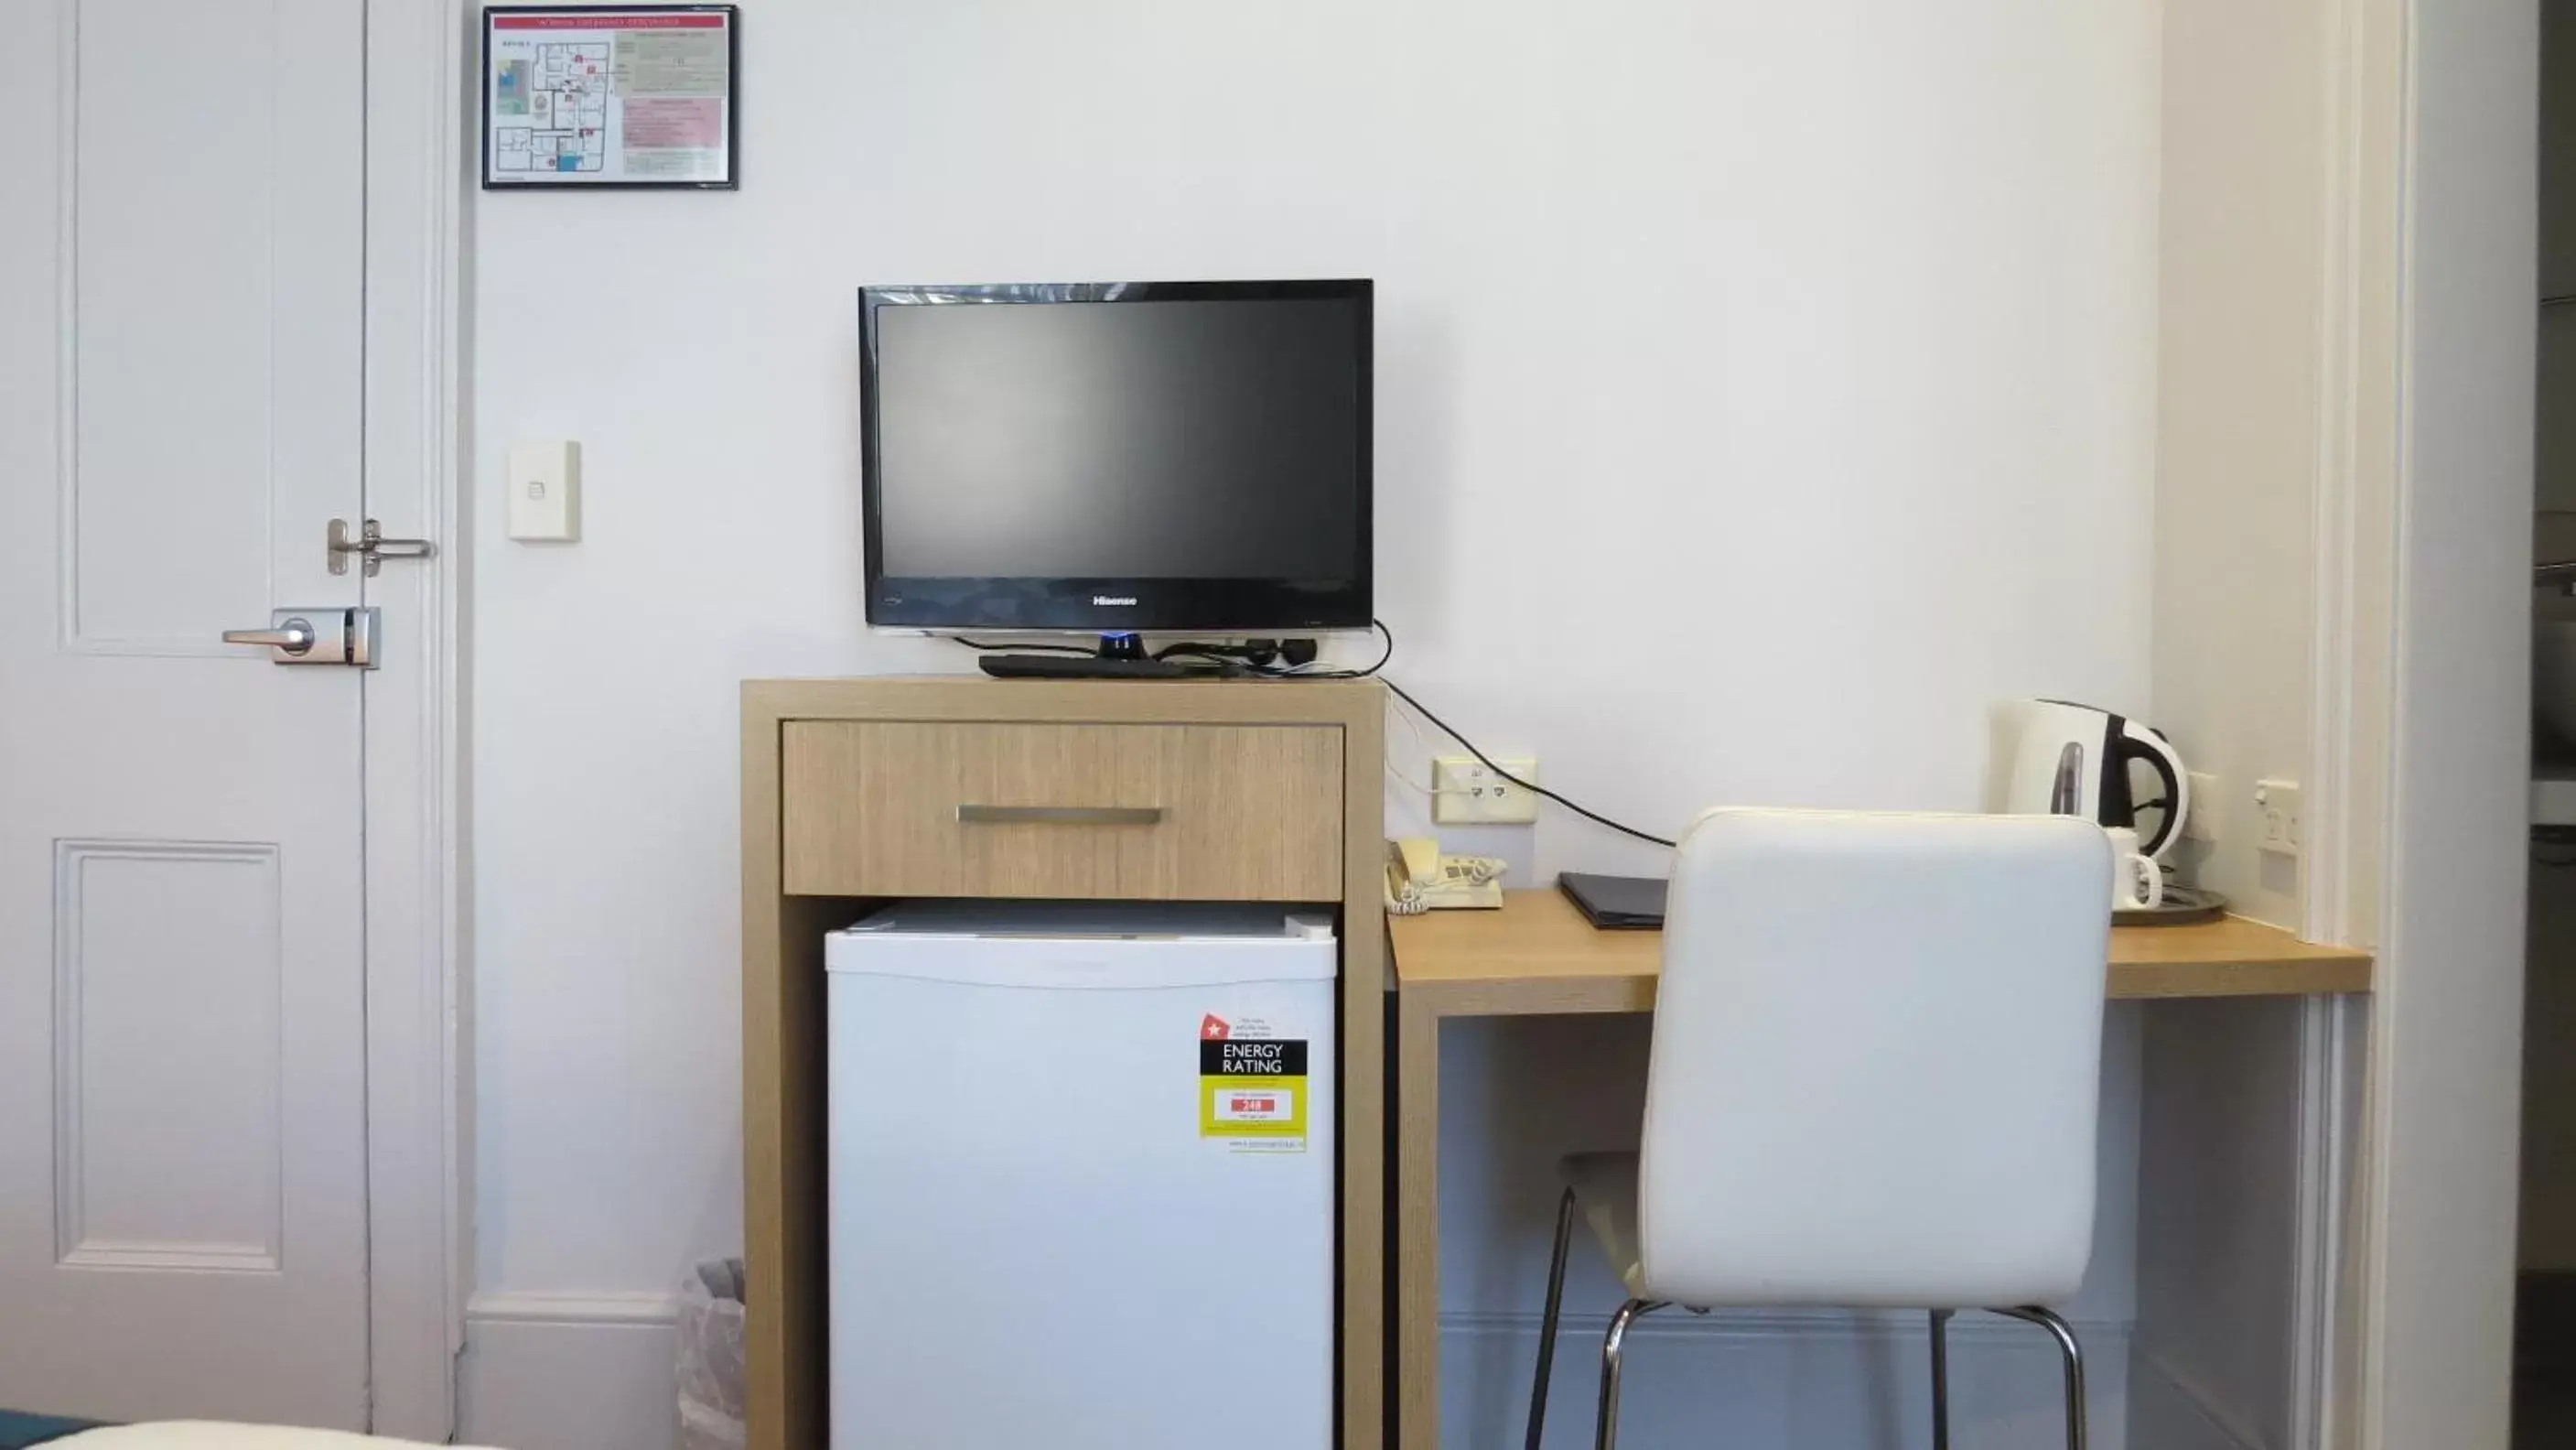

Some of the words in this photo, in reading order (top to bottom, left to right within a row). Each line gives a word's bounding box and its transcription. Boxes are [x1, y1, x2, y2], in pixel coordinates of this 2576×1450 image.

[1093, 596, 1137, 606] Hisense
[1223, 1044, 1283, 1057] ENERGY
[1223, 1059, 1282, 1073] RATING
